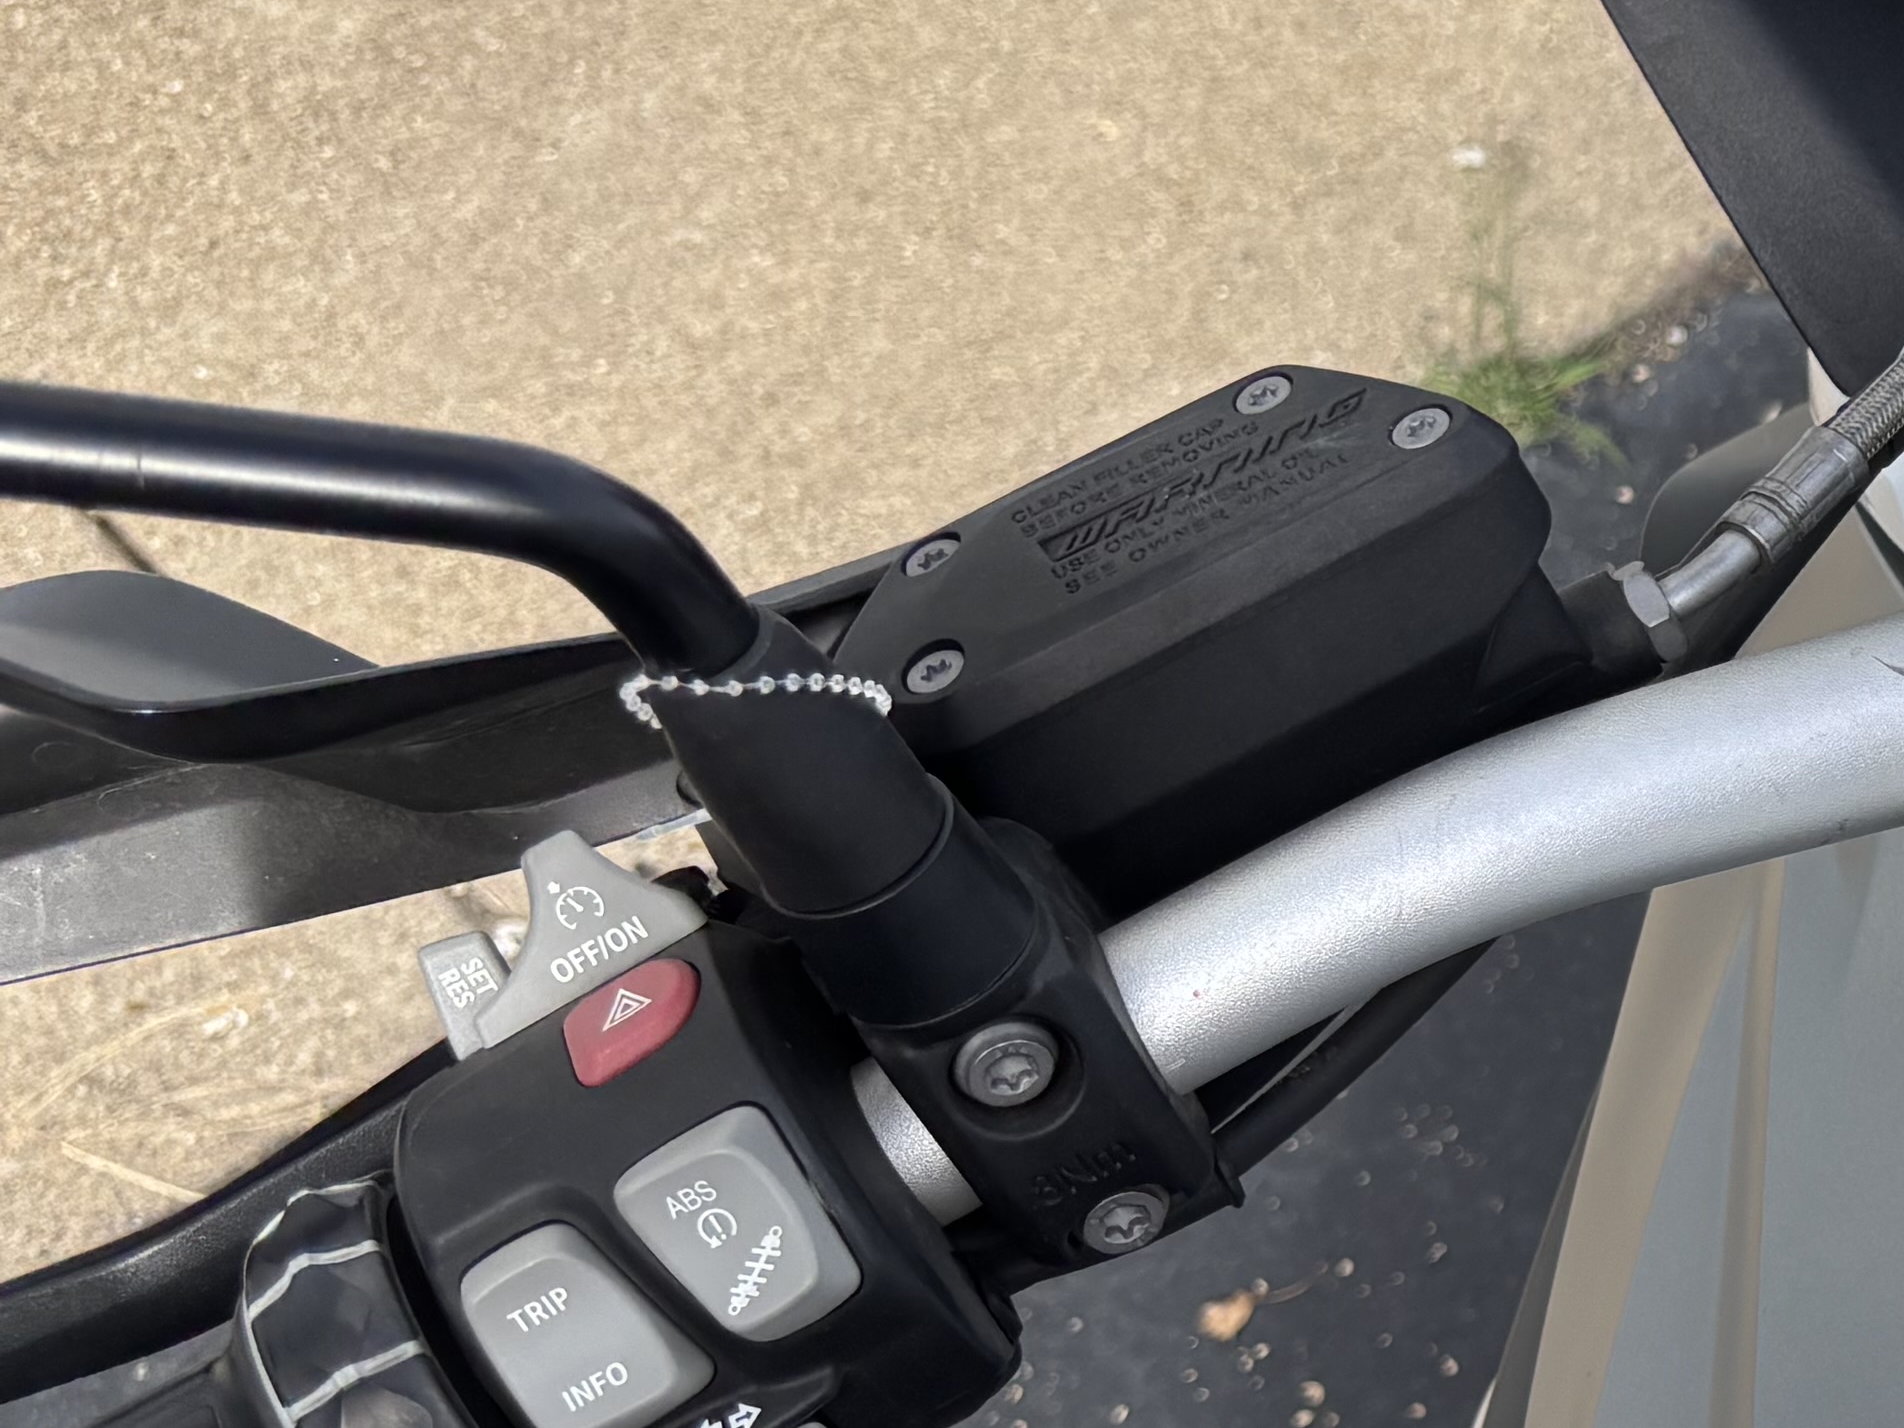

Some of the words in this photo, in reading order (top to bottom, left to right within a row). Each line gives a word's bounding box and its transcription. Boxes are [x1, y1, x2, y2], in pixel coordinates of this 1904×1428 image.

[549, 914, 650, 984] OFF/ON
[437, 966, 476, 1009] RES
[460, 957, 499, 995] SET
[664, 1179, 718, 1221] ABS
[505, 1286, 570, 1333] TRIP
[560, 1361, 629, 1413] INFO
